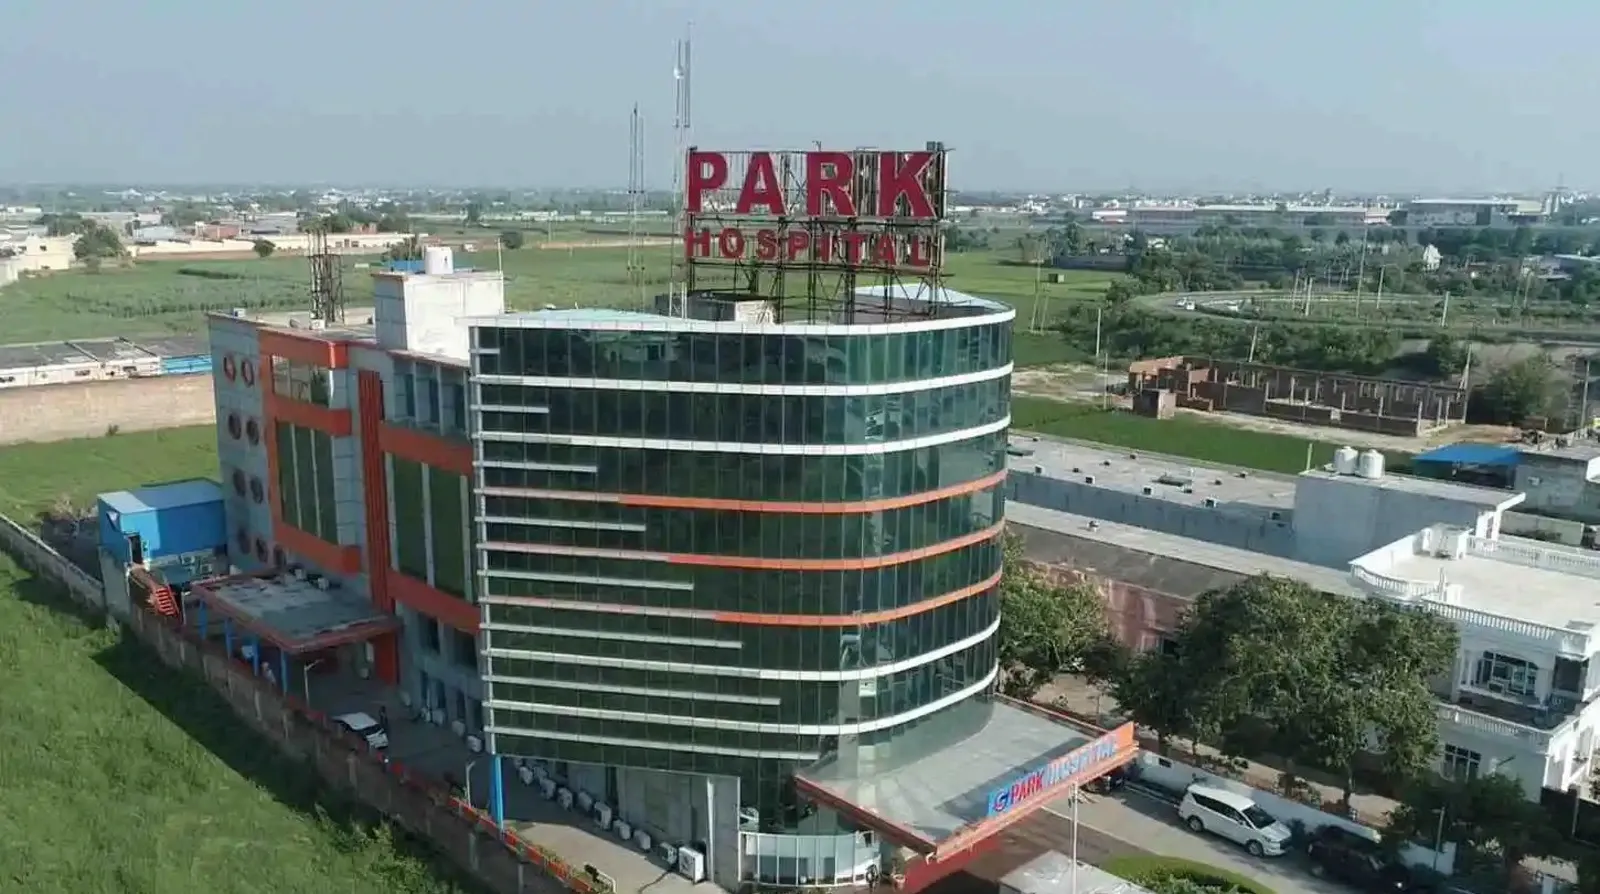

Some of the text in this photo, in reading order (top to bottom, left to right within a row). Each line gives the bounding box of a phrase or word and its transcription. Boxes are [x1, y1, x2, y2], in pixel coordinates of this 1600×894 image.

[687, 151, 936, 217] PARK
[685, 227, 931, 266] HOSPITAL
[1010, 770, 1044, 803] PARK
